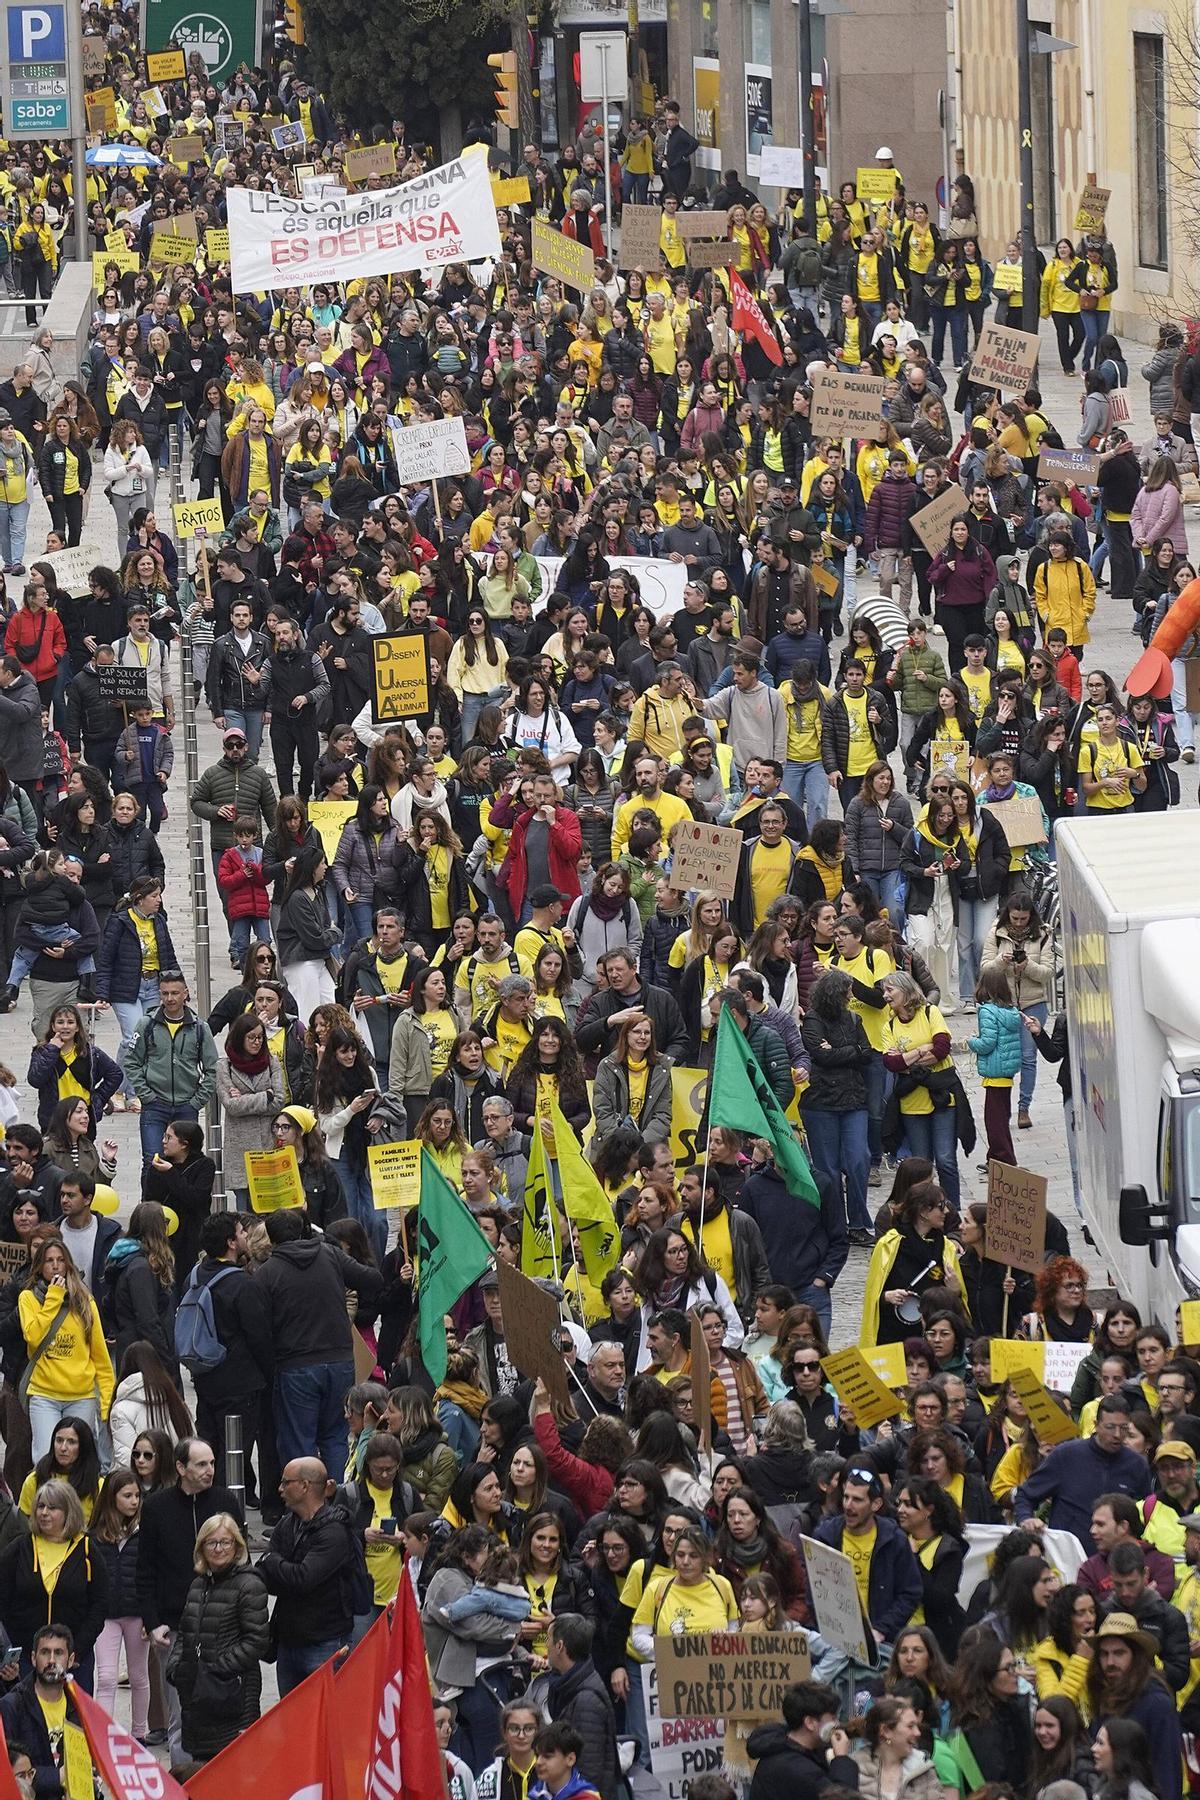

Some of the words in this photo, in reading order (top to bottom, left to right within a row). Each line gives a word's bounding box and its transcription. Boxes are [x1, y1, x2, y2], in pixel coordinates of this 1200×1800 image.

[22, 10, 52, 57] P
[17, 102, 56, 118] saba
[282, 213, 309, 234] és
[315, 201, 393, 234] aquella
[399, 191, 441, 219] que
[271, 238, 309, 266] ES
[318, 210, 462, 260] DEFENSA
[987, 330, 1027, 353] TENIM
[817, 406, 829, 415] PER
[832, 408, 844, 418] NO
[100, 667, 115, 676] CAP
[117, 669, 146, 679] SOLUCIÓ
[682, 824, 701, 840] NO
[707, 829, 740, 848] VOLEM
[680, 872, 691, 882] EL
[1056, 1349, 1068, 1357] EL
[672, 1635, 708, 1658] UNA
[711, 1635, 749, 1656] BONA
[751, 1633, 808, 1656] EDUCACIÓ
[708, 1663, 726, 1680] NO
[733, 1662, 791, 1681] MEREIX
[673, 1681, 737, 1715] PARETS
[741, 1683, 754, 1711] DE
